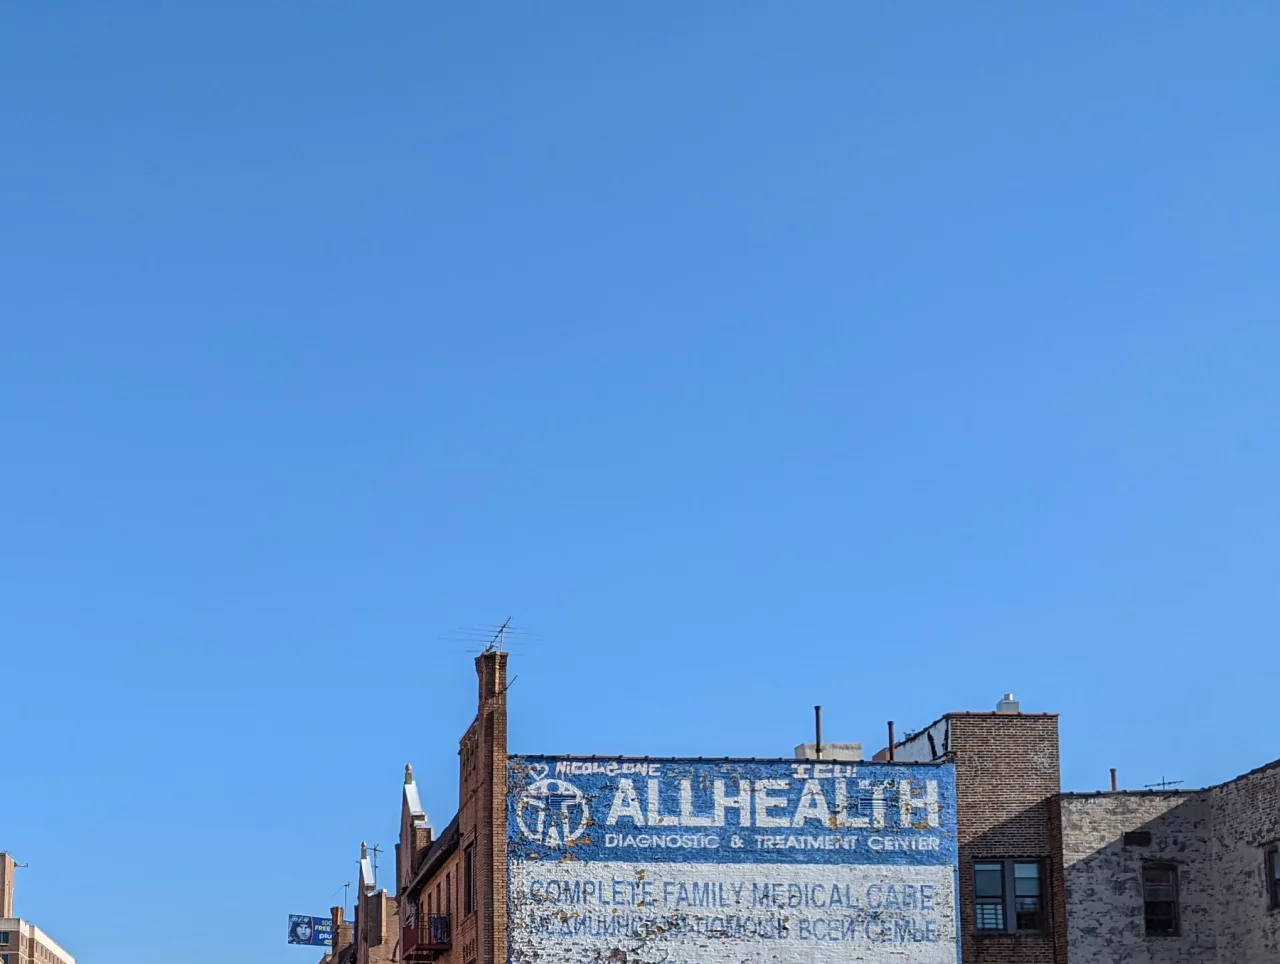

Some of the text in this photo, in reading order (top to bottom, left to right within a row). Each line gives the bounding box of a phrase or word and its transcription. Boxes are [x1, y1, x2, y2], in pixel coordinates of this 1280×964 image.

[605, 778, 939, 828] ALLHEALTH
[605, 833, 940, 851] DIAGNOSTIC & TREATMENT CENTER
[529, 879, 935, 911] COMPLETE FAMILY MEDICAL CARE
